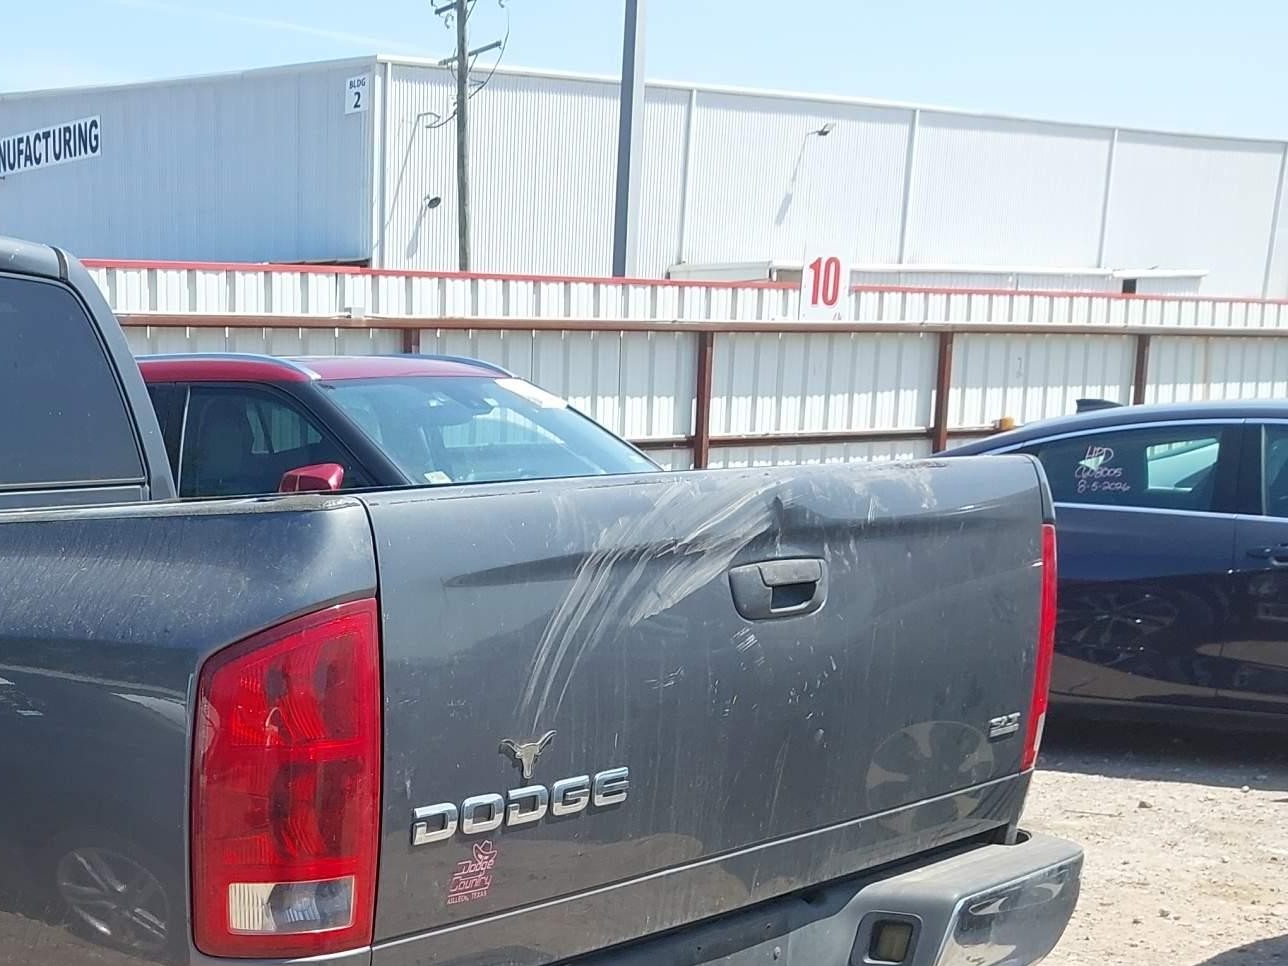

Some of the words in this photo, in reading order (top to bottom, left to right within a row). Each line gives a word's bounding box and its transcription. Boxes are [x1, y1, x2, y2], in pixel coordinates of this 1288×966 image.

[349, 78, 366, 89] BLDG
[353, 91, 361, 109] 2
[809, 256, 841, 306] 10
[412, 766, 629, 846] DODGE
[453, 859, 495, 879] Dodge
